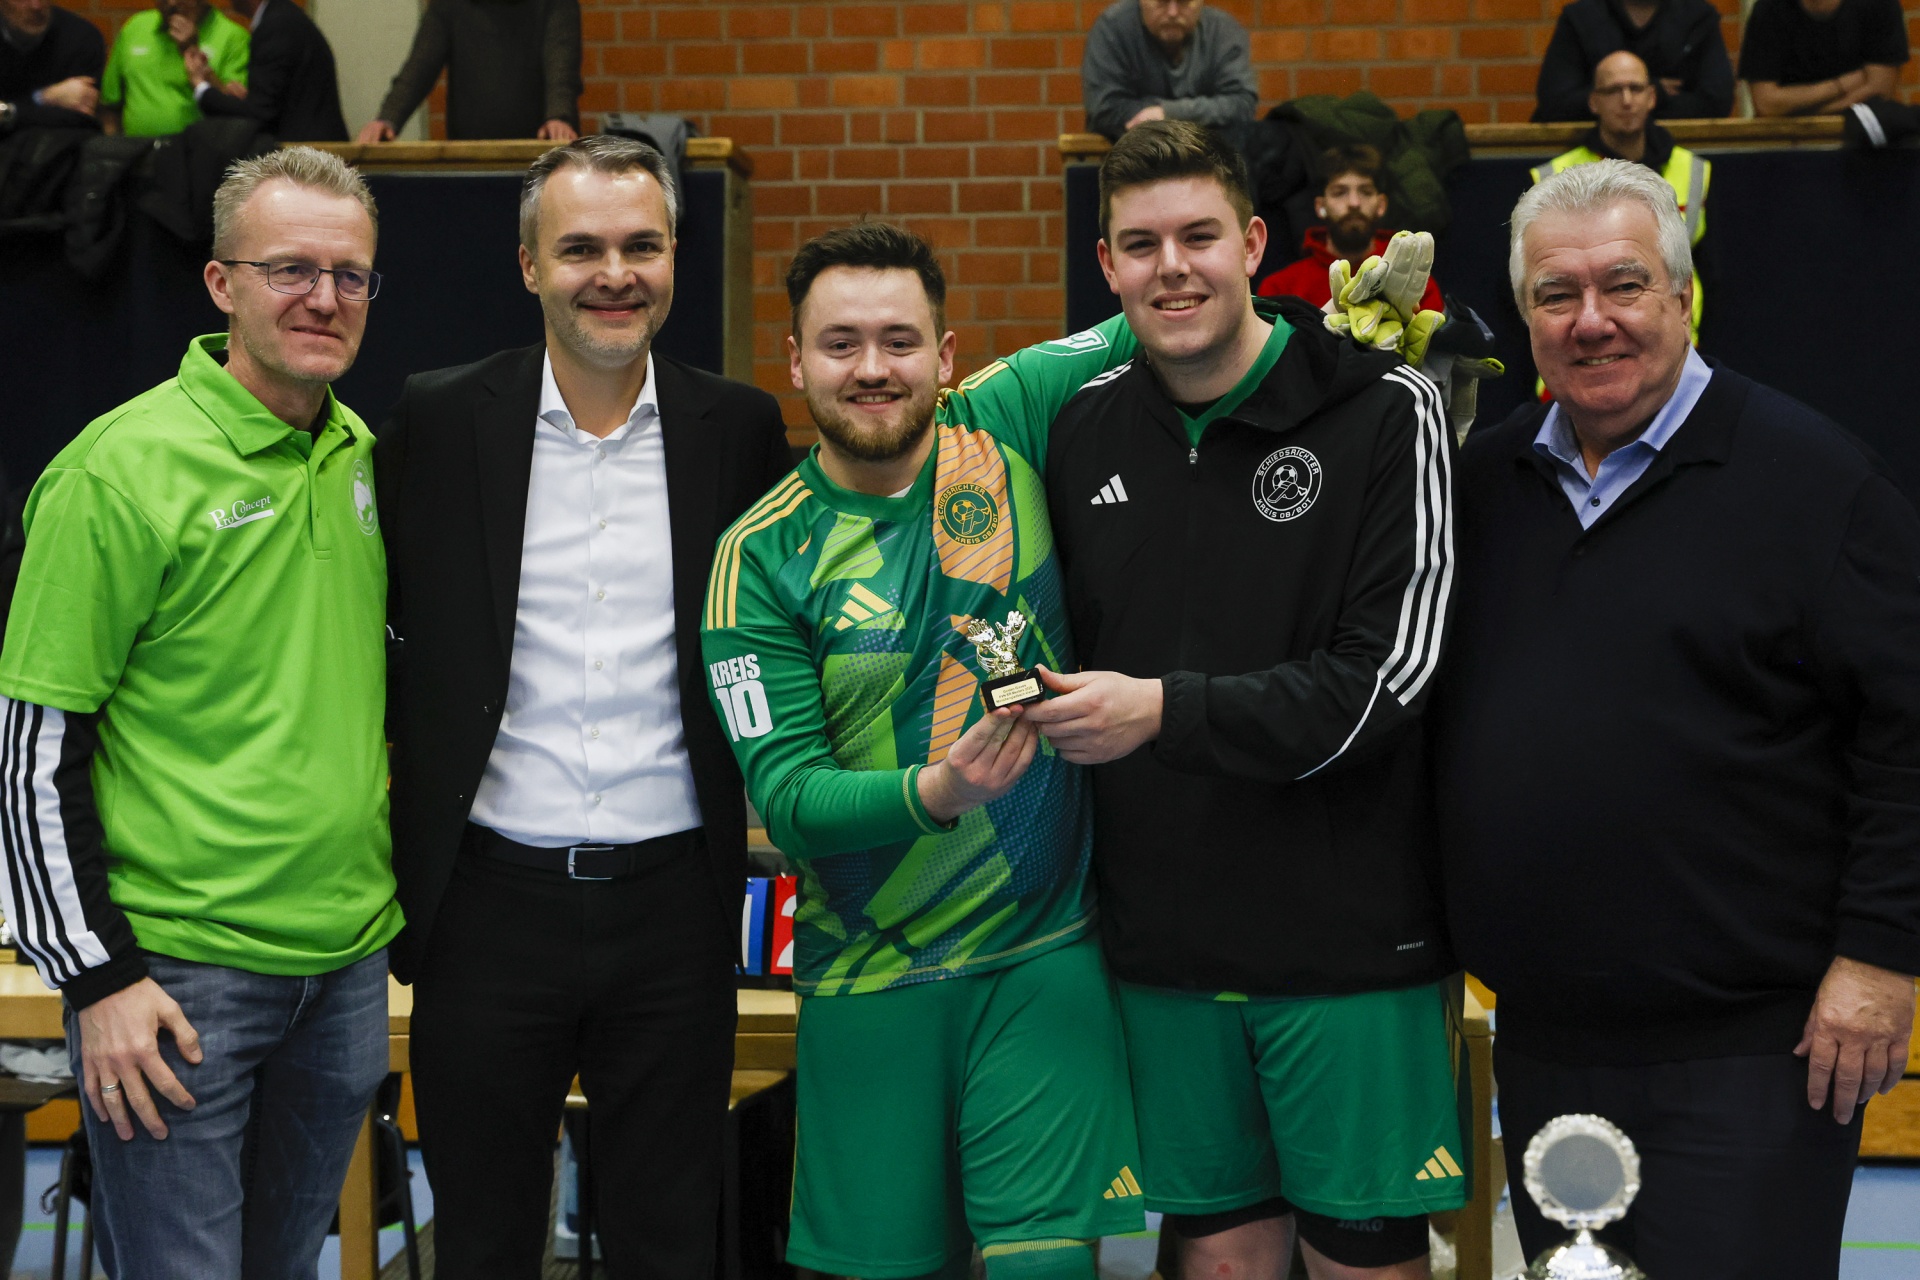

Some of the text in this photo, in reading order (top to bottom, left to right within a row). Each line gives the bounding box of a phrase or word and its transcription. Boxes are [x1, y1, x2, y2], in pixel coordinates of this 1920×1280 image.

[1257, 448, 1320, 477] SCHIEDSRICHTER
[938, 484, 986, 521] SCHIEDSRICHTER
[1256, 497, 1312, 519] KREIS OB/BOT
[955, 535, 981, 545] KREIS
[709, 653, 761, 688] KREIS
[714, 680, 774, 742] 10
